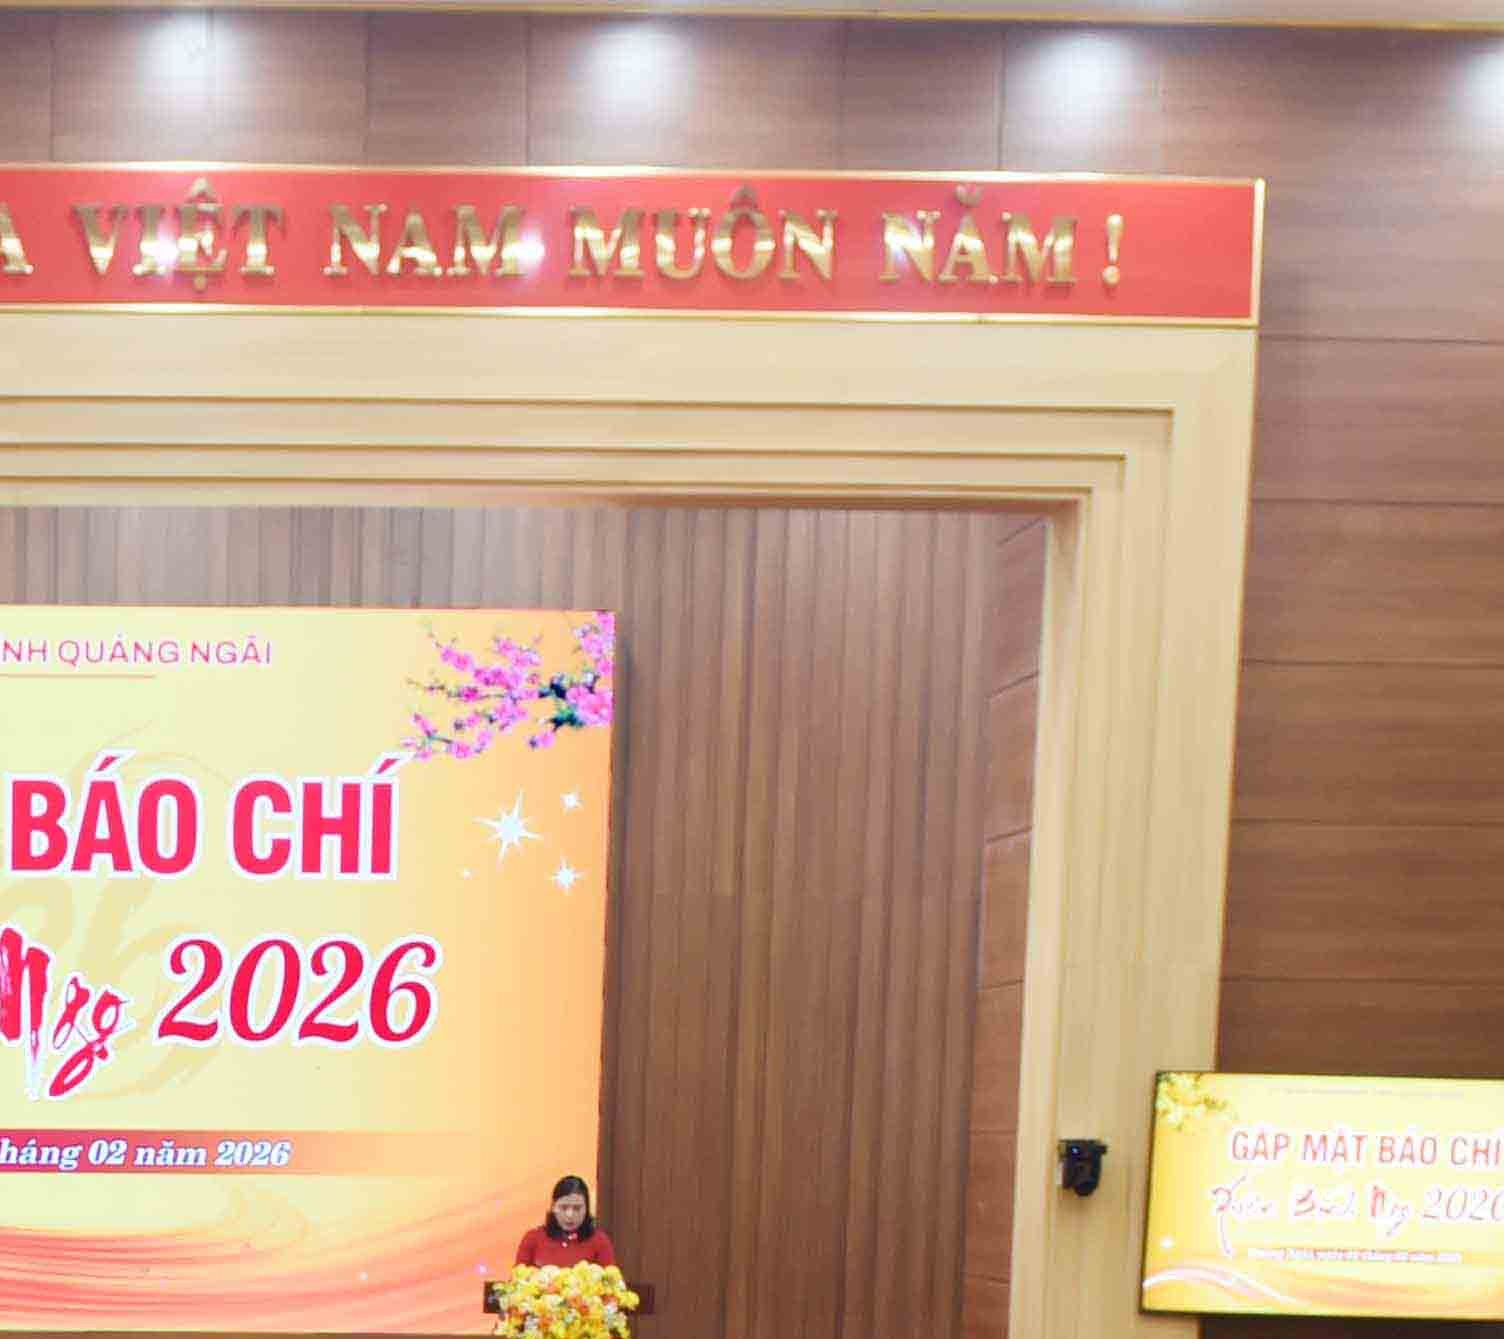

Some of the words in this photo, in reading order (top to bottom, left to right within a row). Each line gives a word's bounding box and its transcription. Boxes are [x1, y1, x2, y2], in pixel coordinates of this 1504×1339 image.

[70, 177, 287, 292] VIỆT
[323, 203, 528, 277] NAM
[568, 184, 840, 281] MUÔN
[878, 183, 1077, 284] NĂM
[190, 635, 272, 665] NGÃI
[11, 748, 204, 872] BÁO
[230, 756, 404, 875] CHÍ
[157, 938, 440, 1045] 2026
[87, 1138, 128, 1166] 02
[133, 1140, 208, 1167] năm
[214, 1140, 293, 1168] 2026
